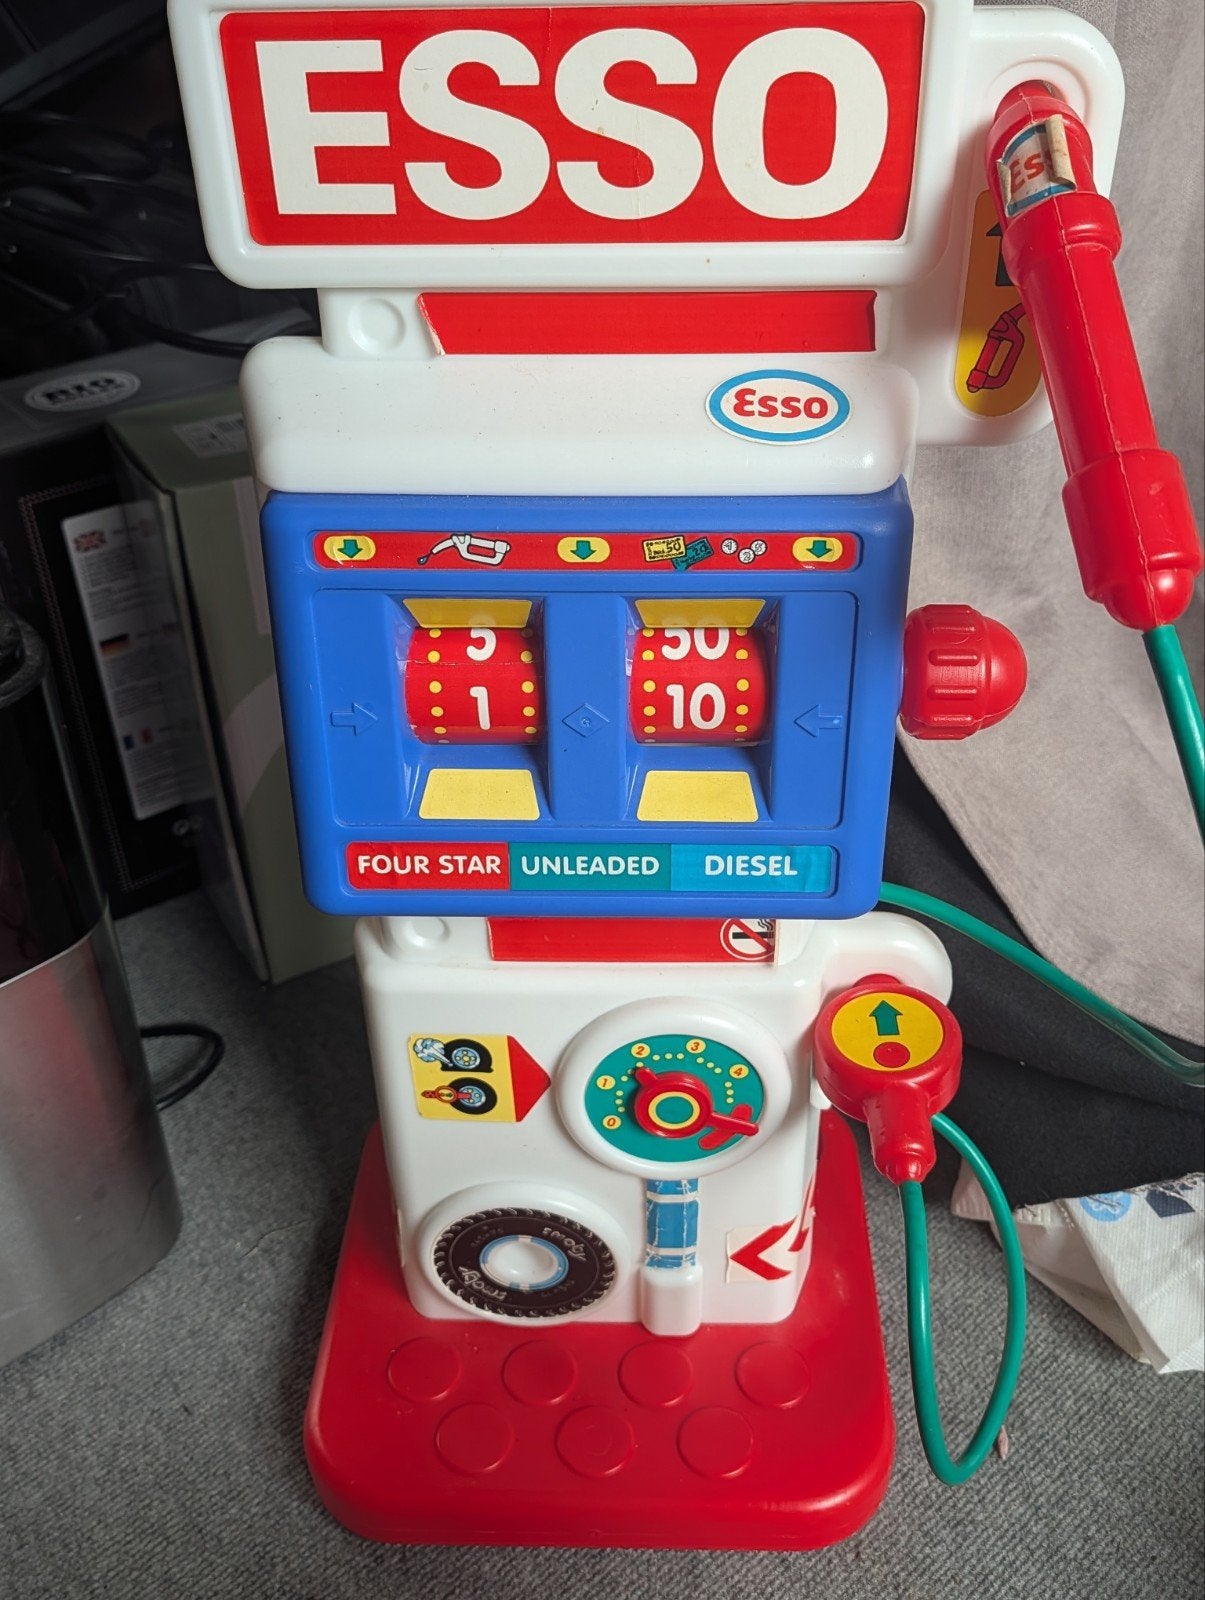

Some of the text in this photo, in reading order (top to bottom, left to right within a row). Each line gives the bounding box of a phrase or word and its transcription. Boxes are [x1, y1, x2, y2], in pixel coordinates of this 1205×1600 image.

[255, 27, 888, 220] ESSO
[733, 388, 828, 419] Esso
[466, 627, 497, 662] 5
[661, 627, 730, 661] 50
[469, 686, 491, 731] 1
[666, 682, 726, 730] 10
[357, 854, 502, 876] FOUR STAR
[521, 855, 660, 876] UNLEADED
[705, 855, 798, 877] DIESEL
[635, 1045, 645, 1056] 2
[690, 1041, 701, 1051] 3
[732, 1067, 743, 1077] 4
